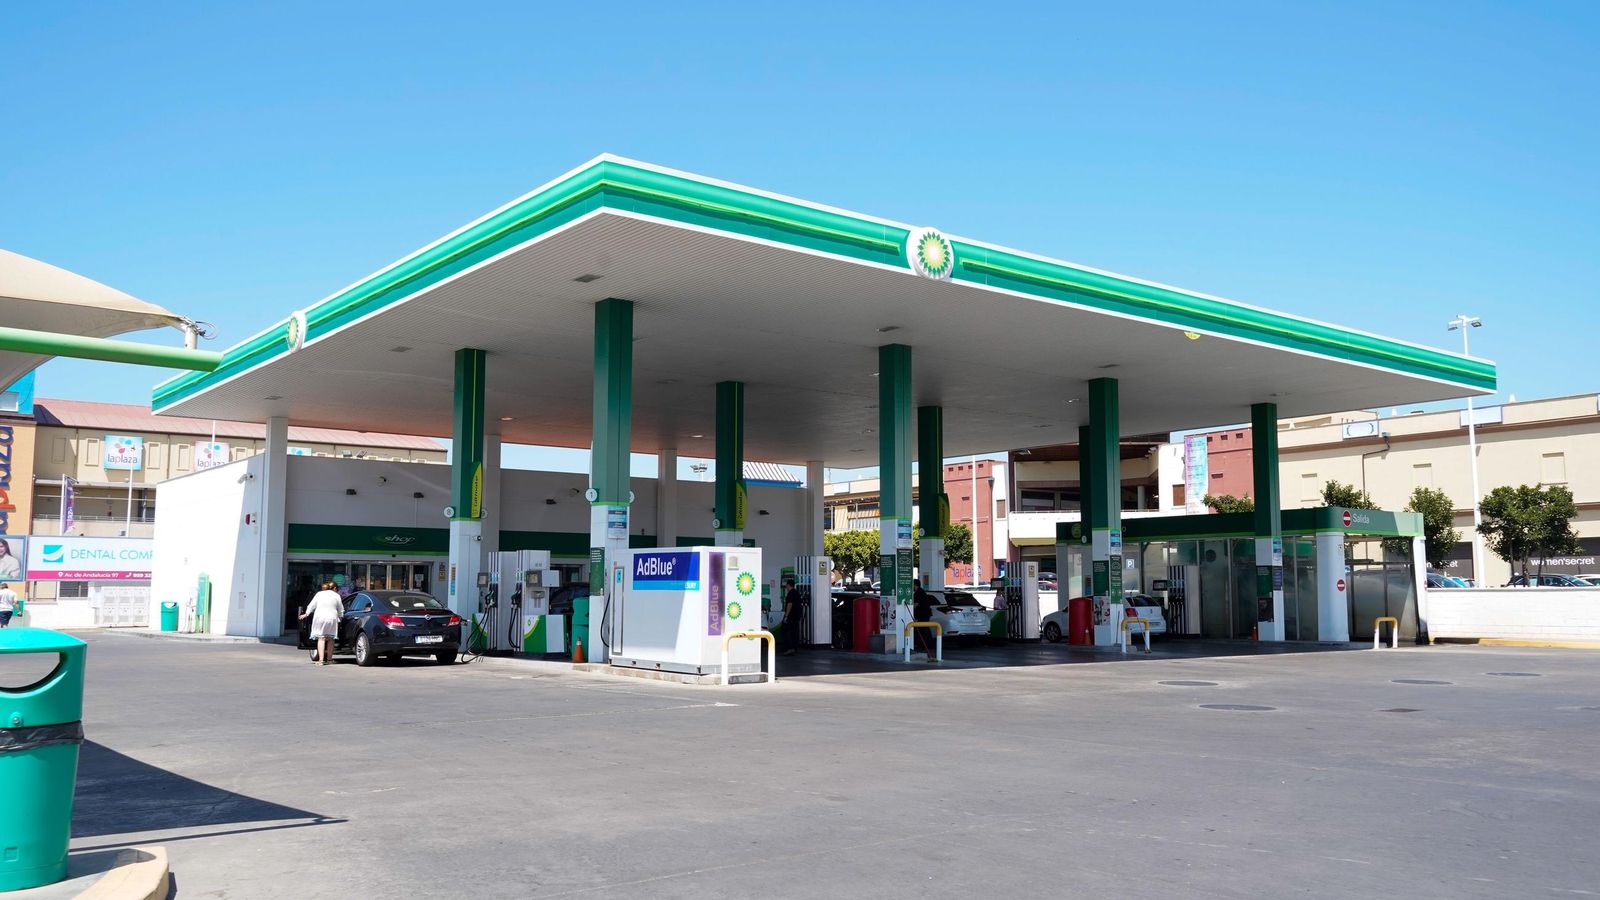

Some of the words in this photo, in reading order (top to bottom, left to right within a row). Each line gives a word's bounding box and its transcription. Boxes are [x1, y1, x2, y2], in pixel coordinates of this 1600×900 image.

[107, 453, 138, 464] laplaza
[1352, 513, 1369, 524] Salida
[384, 534, 416, 545] shop
[70, 548, 115, 560] DENTAL
[953, 566, 982, 580] lapla
[710, 584, 719, 632] AdBlue
